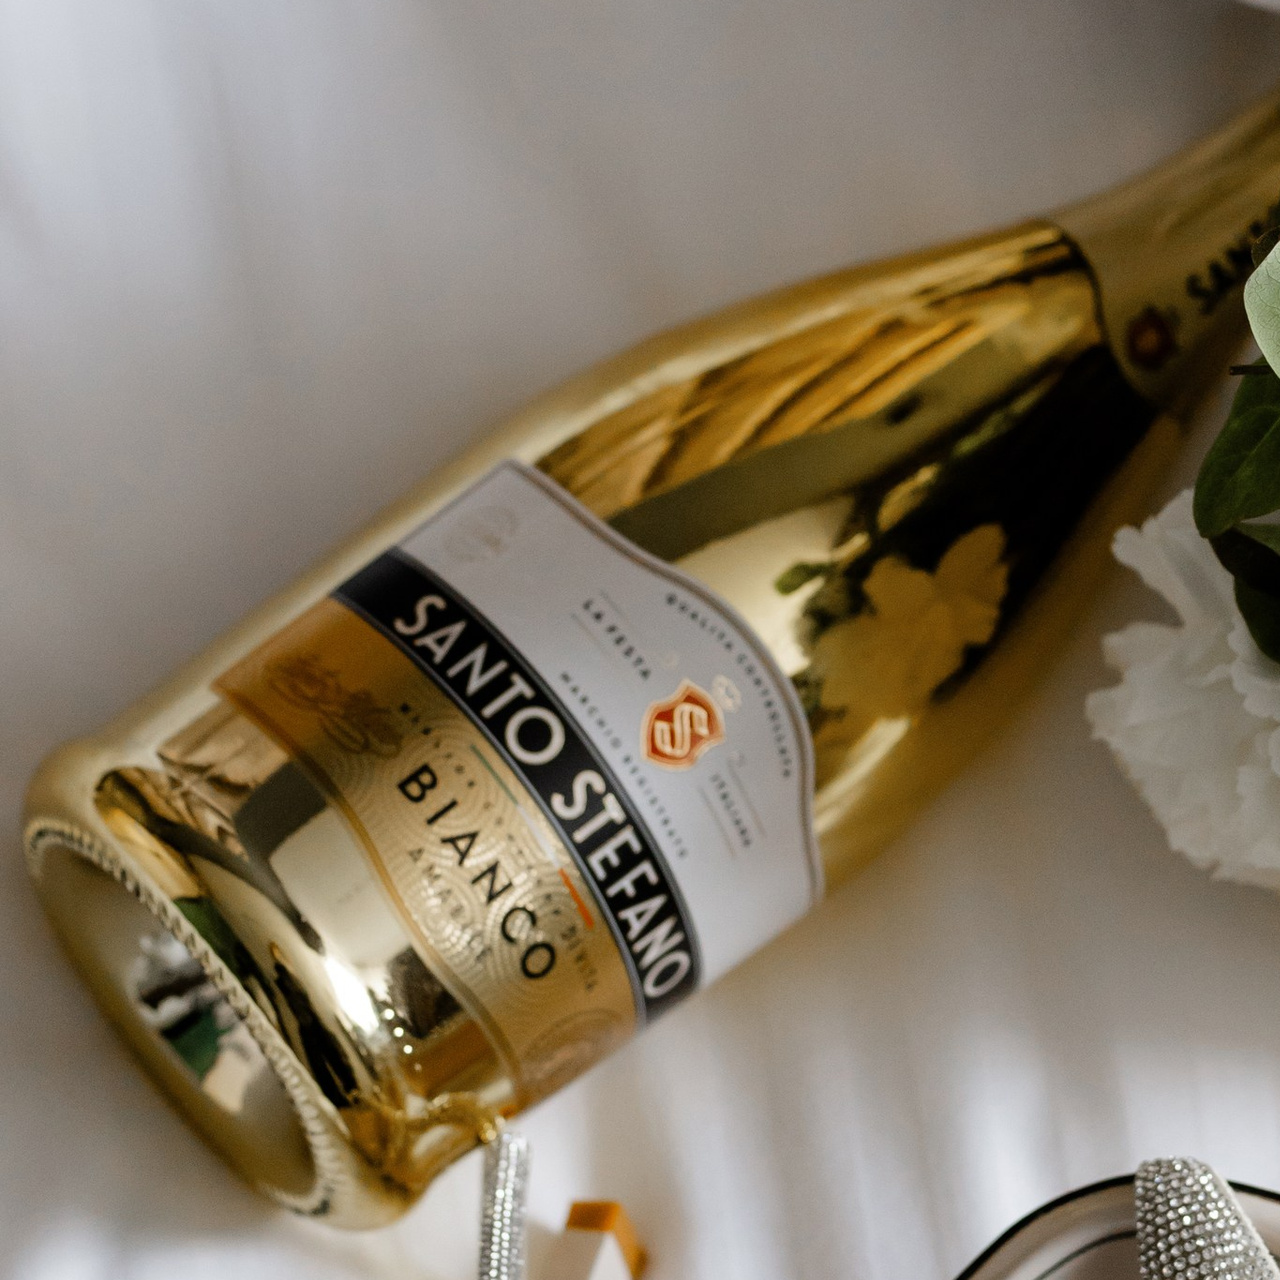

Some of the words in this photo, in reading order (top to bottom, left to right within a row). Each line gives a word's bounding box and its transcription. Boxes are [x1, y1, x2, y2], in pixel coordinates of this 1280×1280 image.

[393, 594, 566, 765] SANTO
[551, 770, 691, 999] STEFANO
[397, 764, 556, 979] BIANCO
